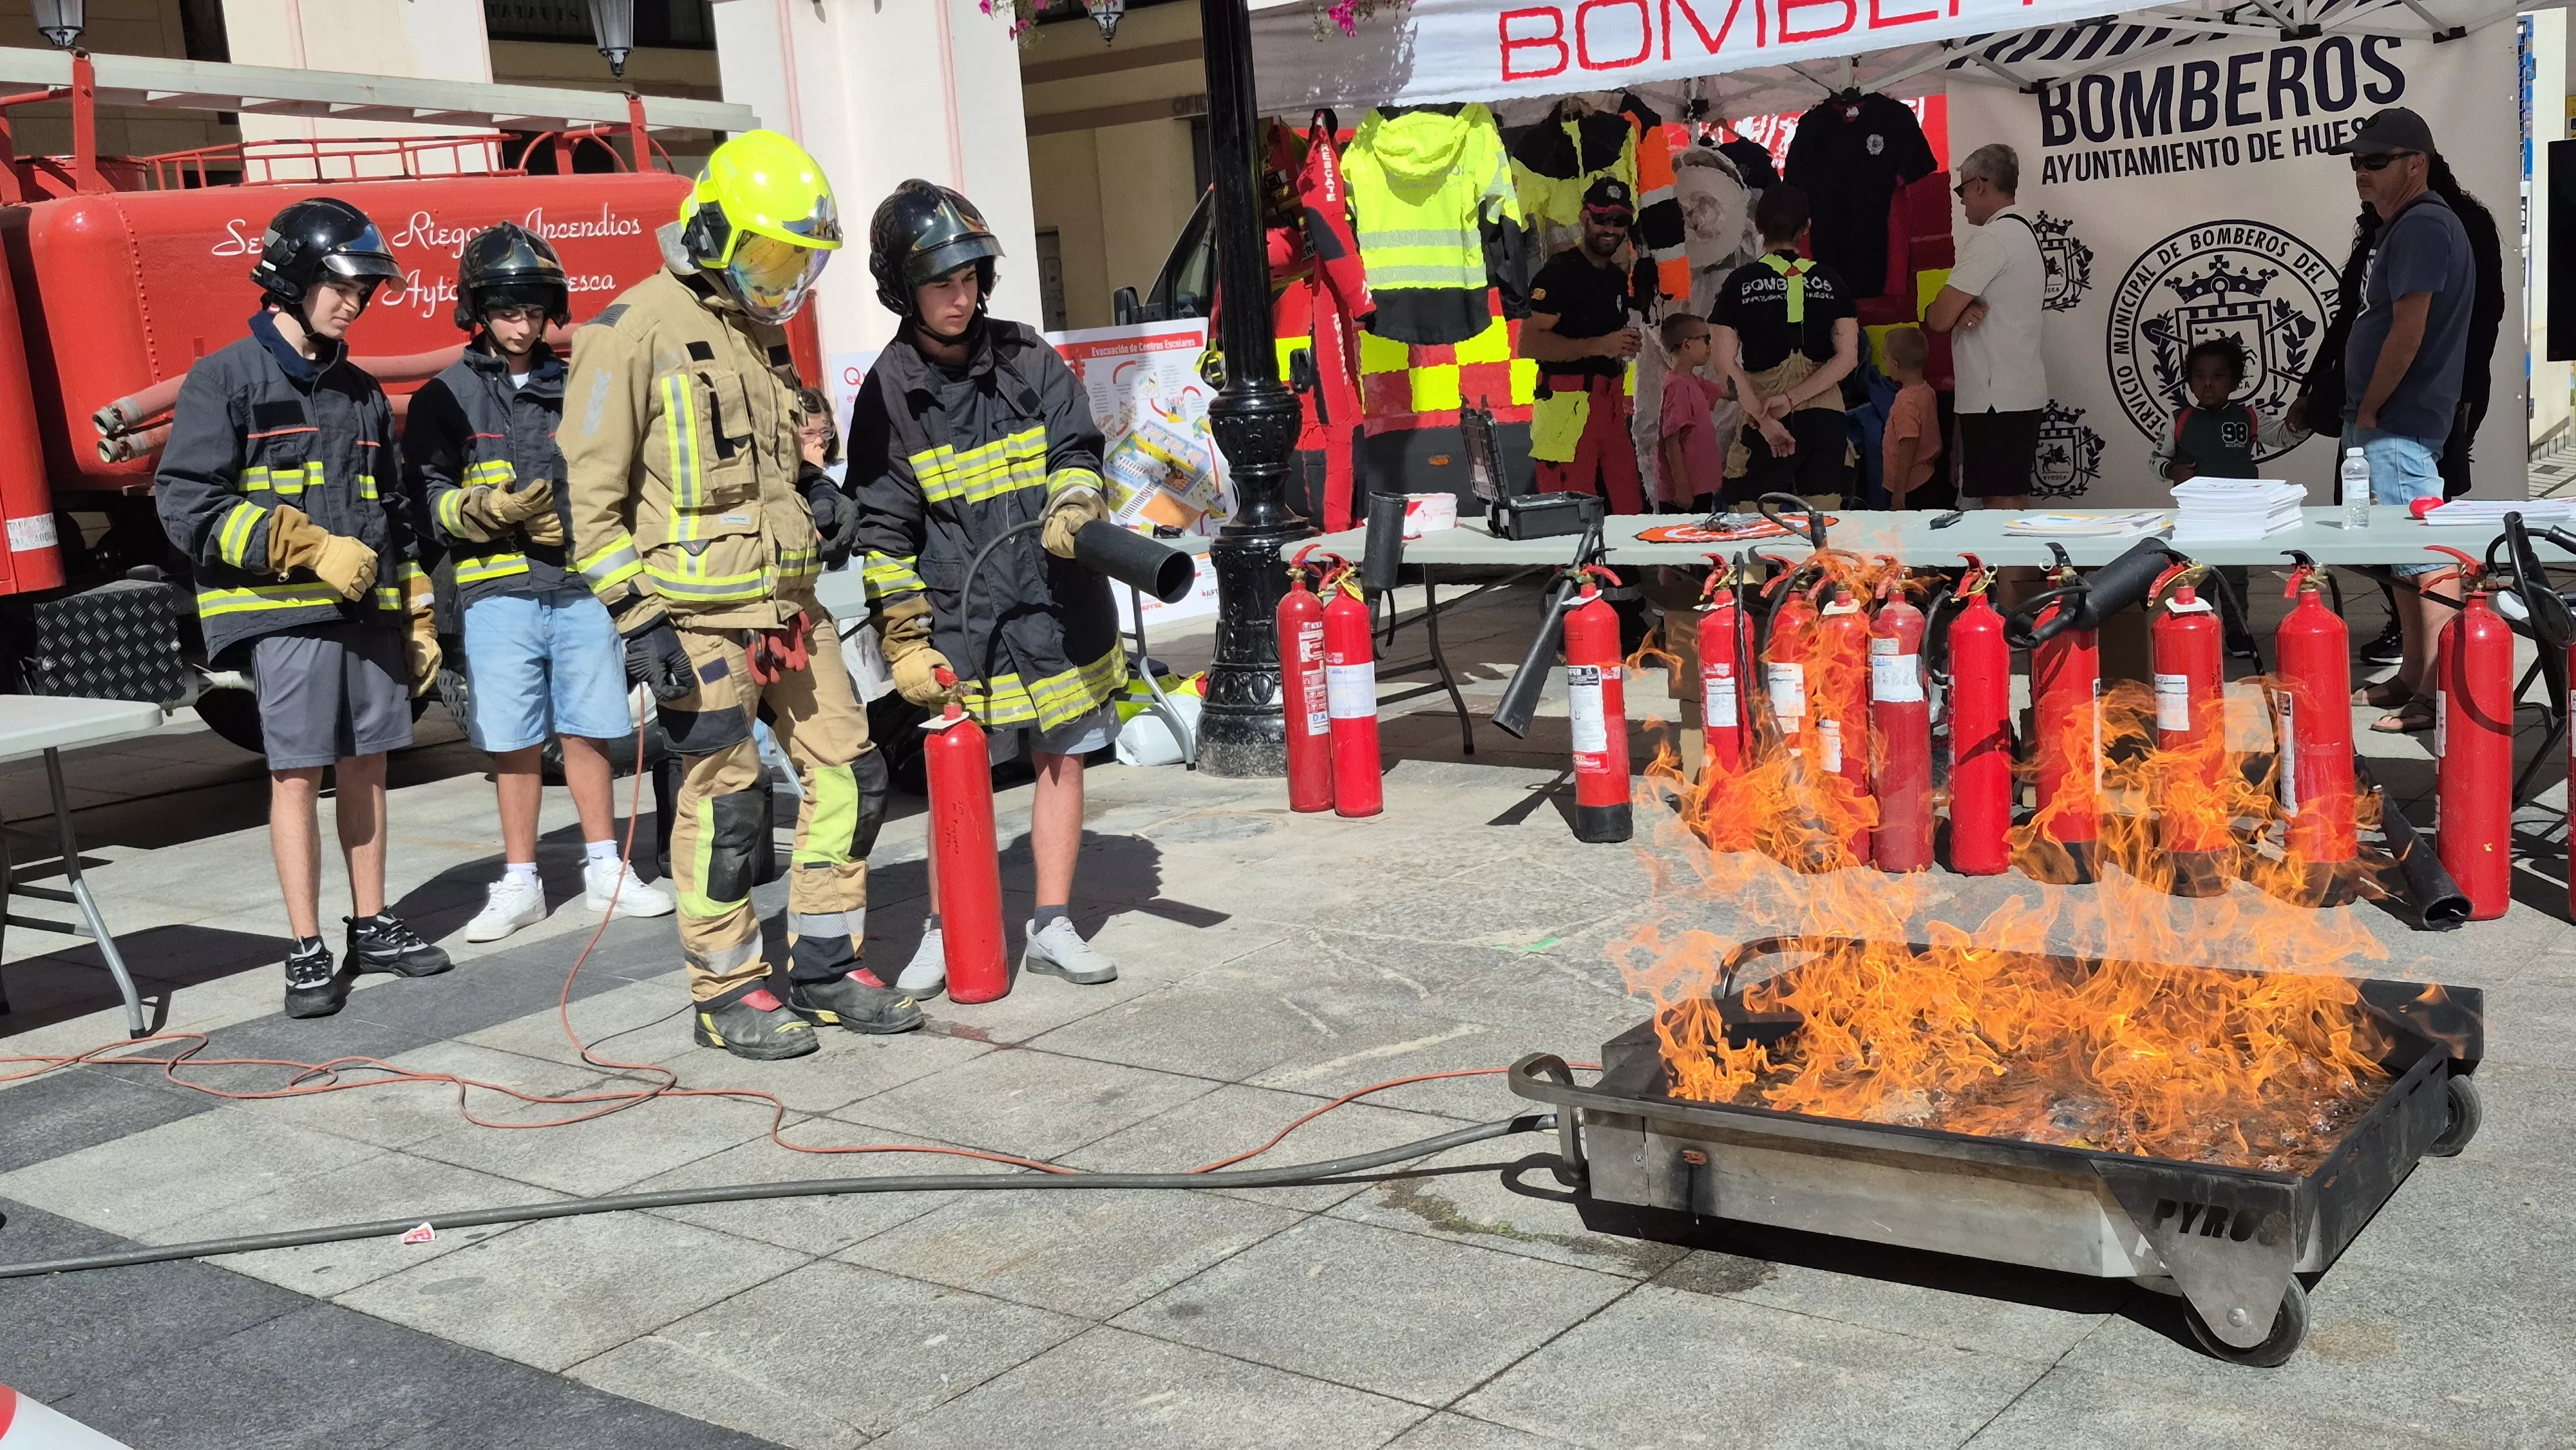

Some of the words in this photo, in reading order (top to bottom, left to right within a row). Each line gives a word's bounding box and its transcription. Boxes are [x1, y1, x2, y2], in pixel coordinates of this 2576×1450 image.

[2038, 34, 2406, 147] BOMBEROS
[1320, 143, 1337, 202] RESCATE
[2041, 135, 2240, 185] AYUNTAMIENTO
[2247, 129, 2282, 164] DE
[525, 202, 643, 240] Incendios
[1741, 276, 1833, 296] BOMBROS
[2114, 265, 2157, 355] MUNICIPAL
[2157, 242, 2182, 265] DE
[2190, 227, 2291, 258] BOMBEROS
[2293, 253, 2325, 285] DEL
[1092, 344, 1129, 357] Evacuación
[1130, 343, 1139, 353] de
[1139, 342, 1164, 352] Centros
[1164, 339, 1196, 349] Escolares
[2221, 422, 2249, 444] 98
